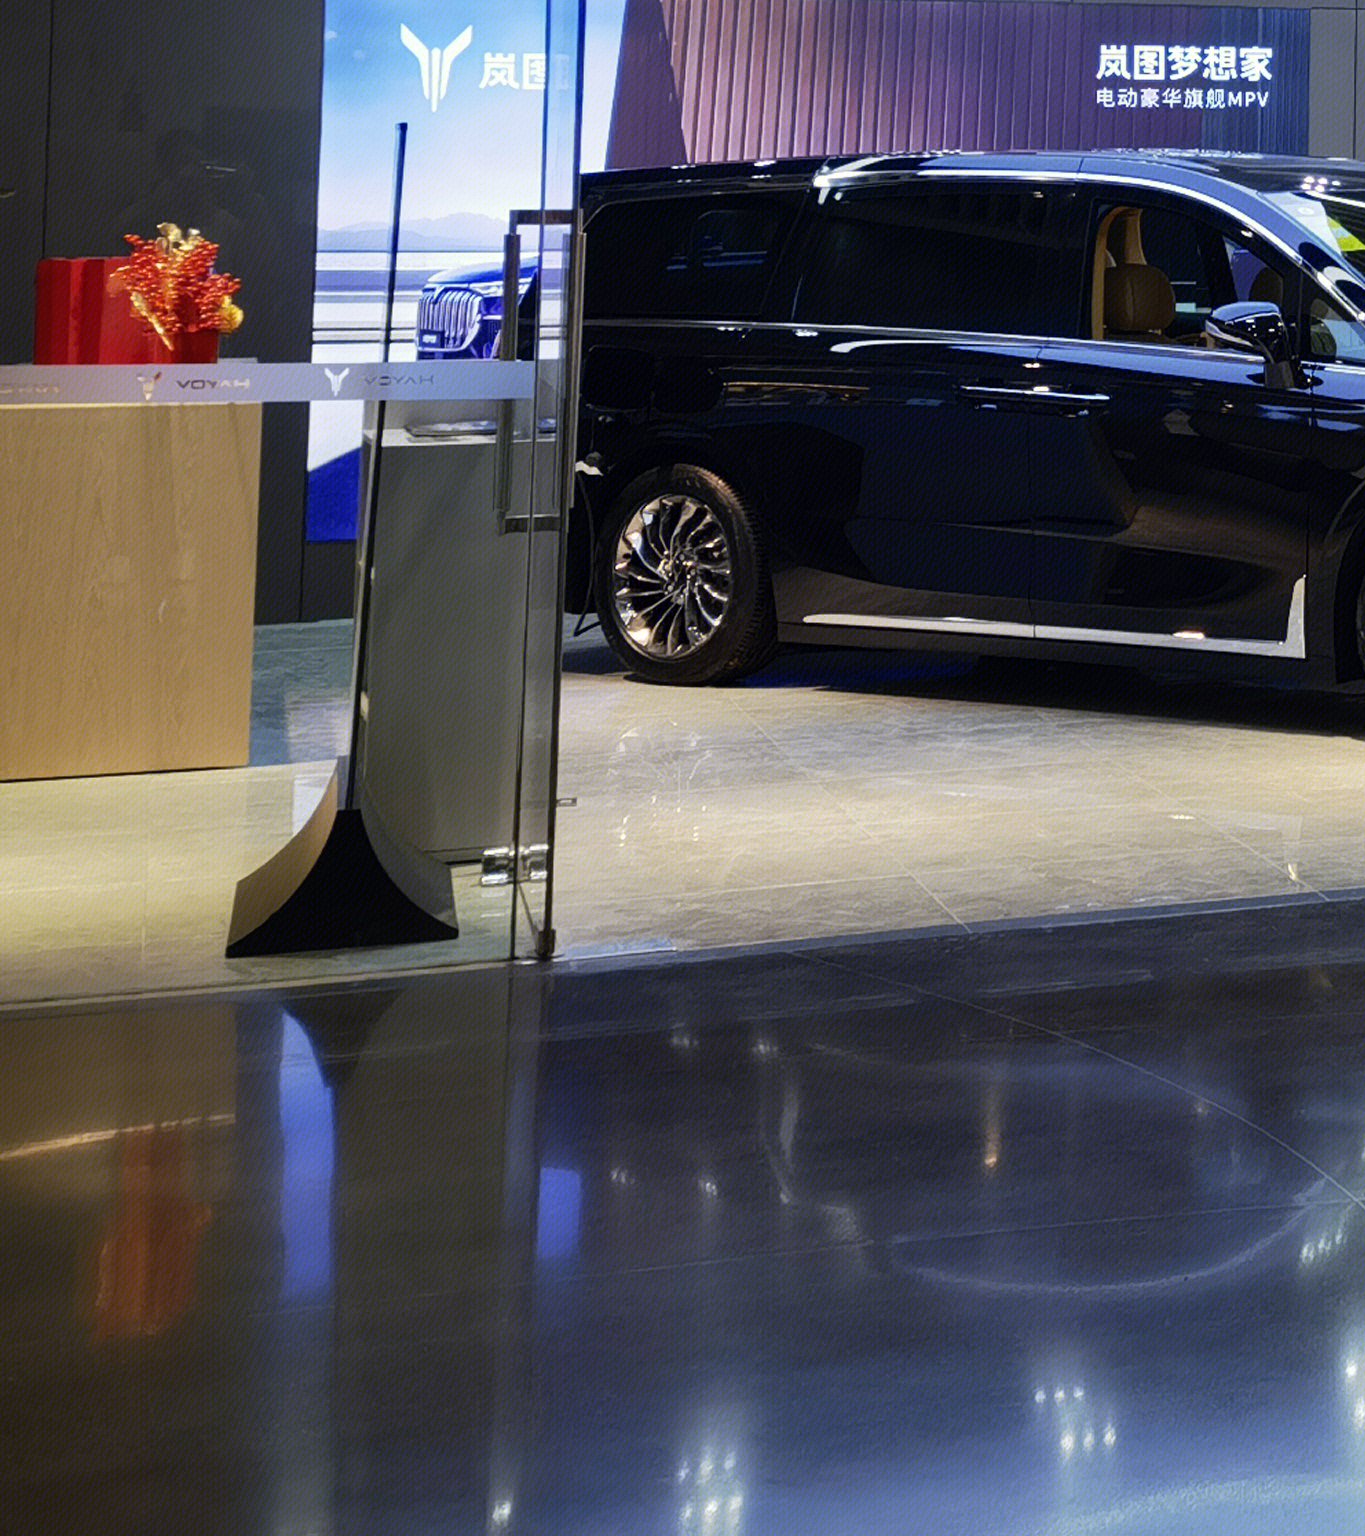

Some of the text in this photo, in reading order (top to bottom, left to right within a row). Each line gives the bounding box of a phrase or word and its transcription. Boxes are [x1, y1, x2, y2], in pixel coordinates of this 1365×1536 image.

[1096, 44, 1273, 82] 岚图梦想家
[1096, 87, 1269, 109] 电动豪华旗舰MPV
[177, 378, 250, 390] VOYAH
[363, 374, 434, 387] VOYAH
